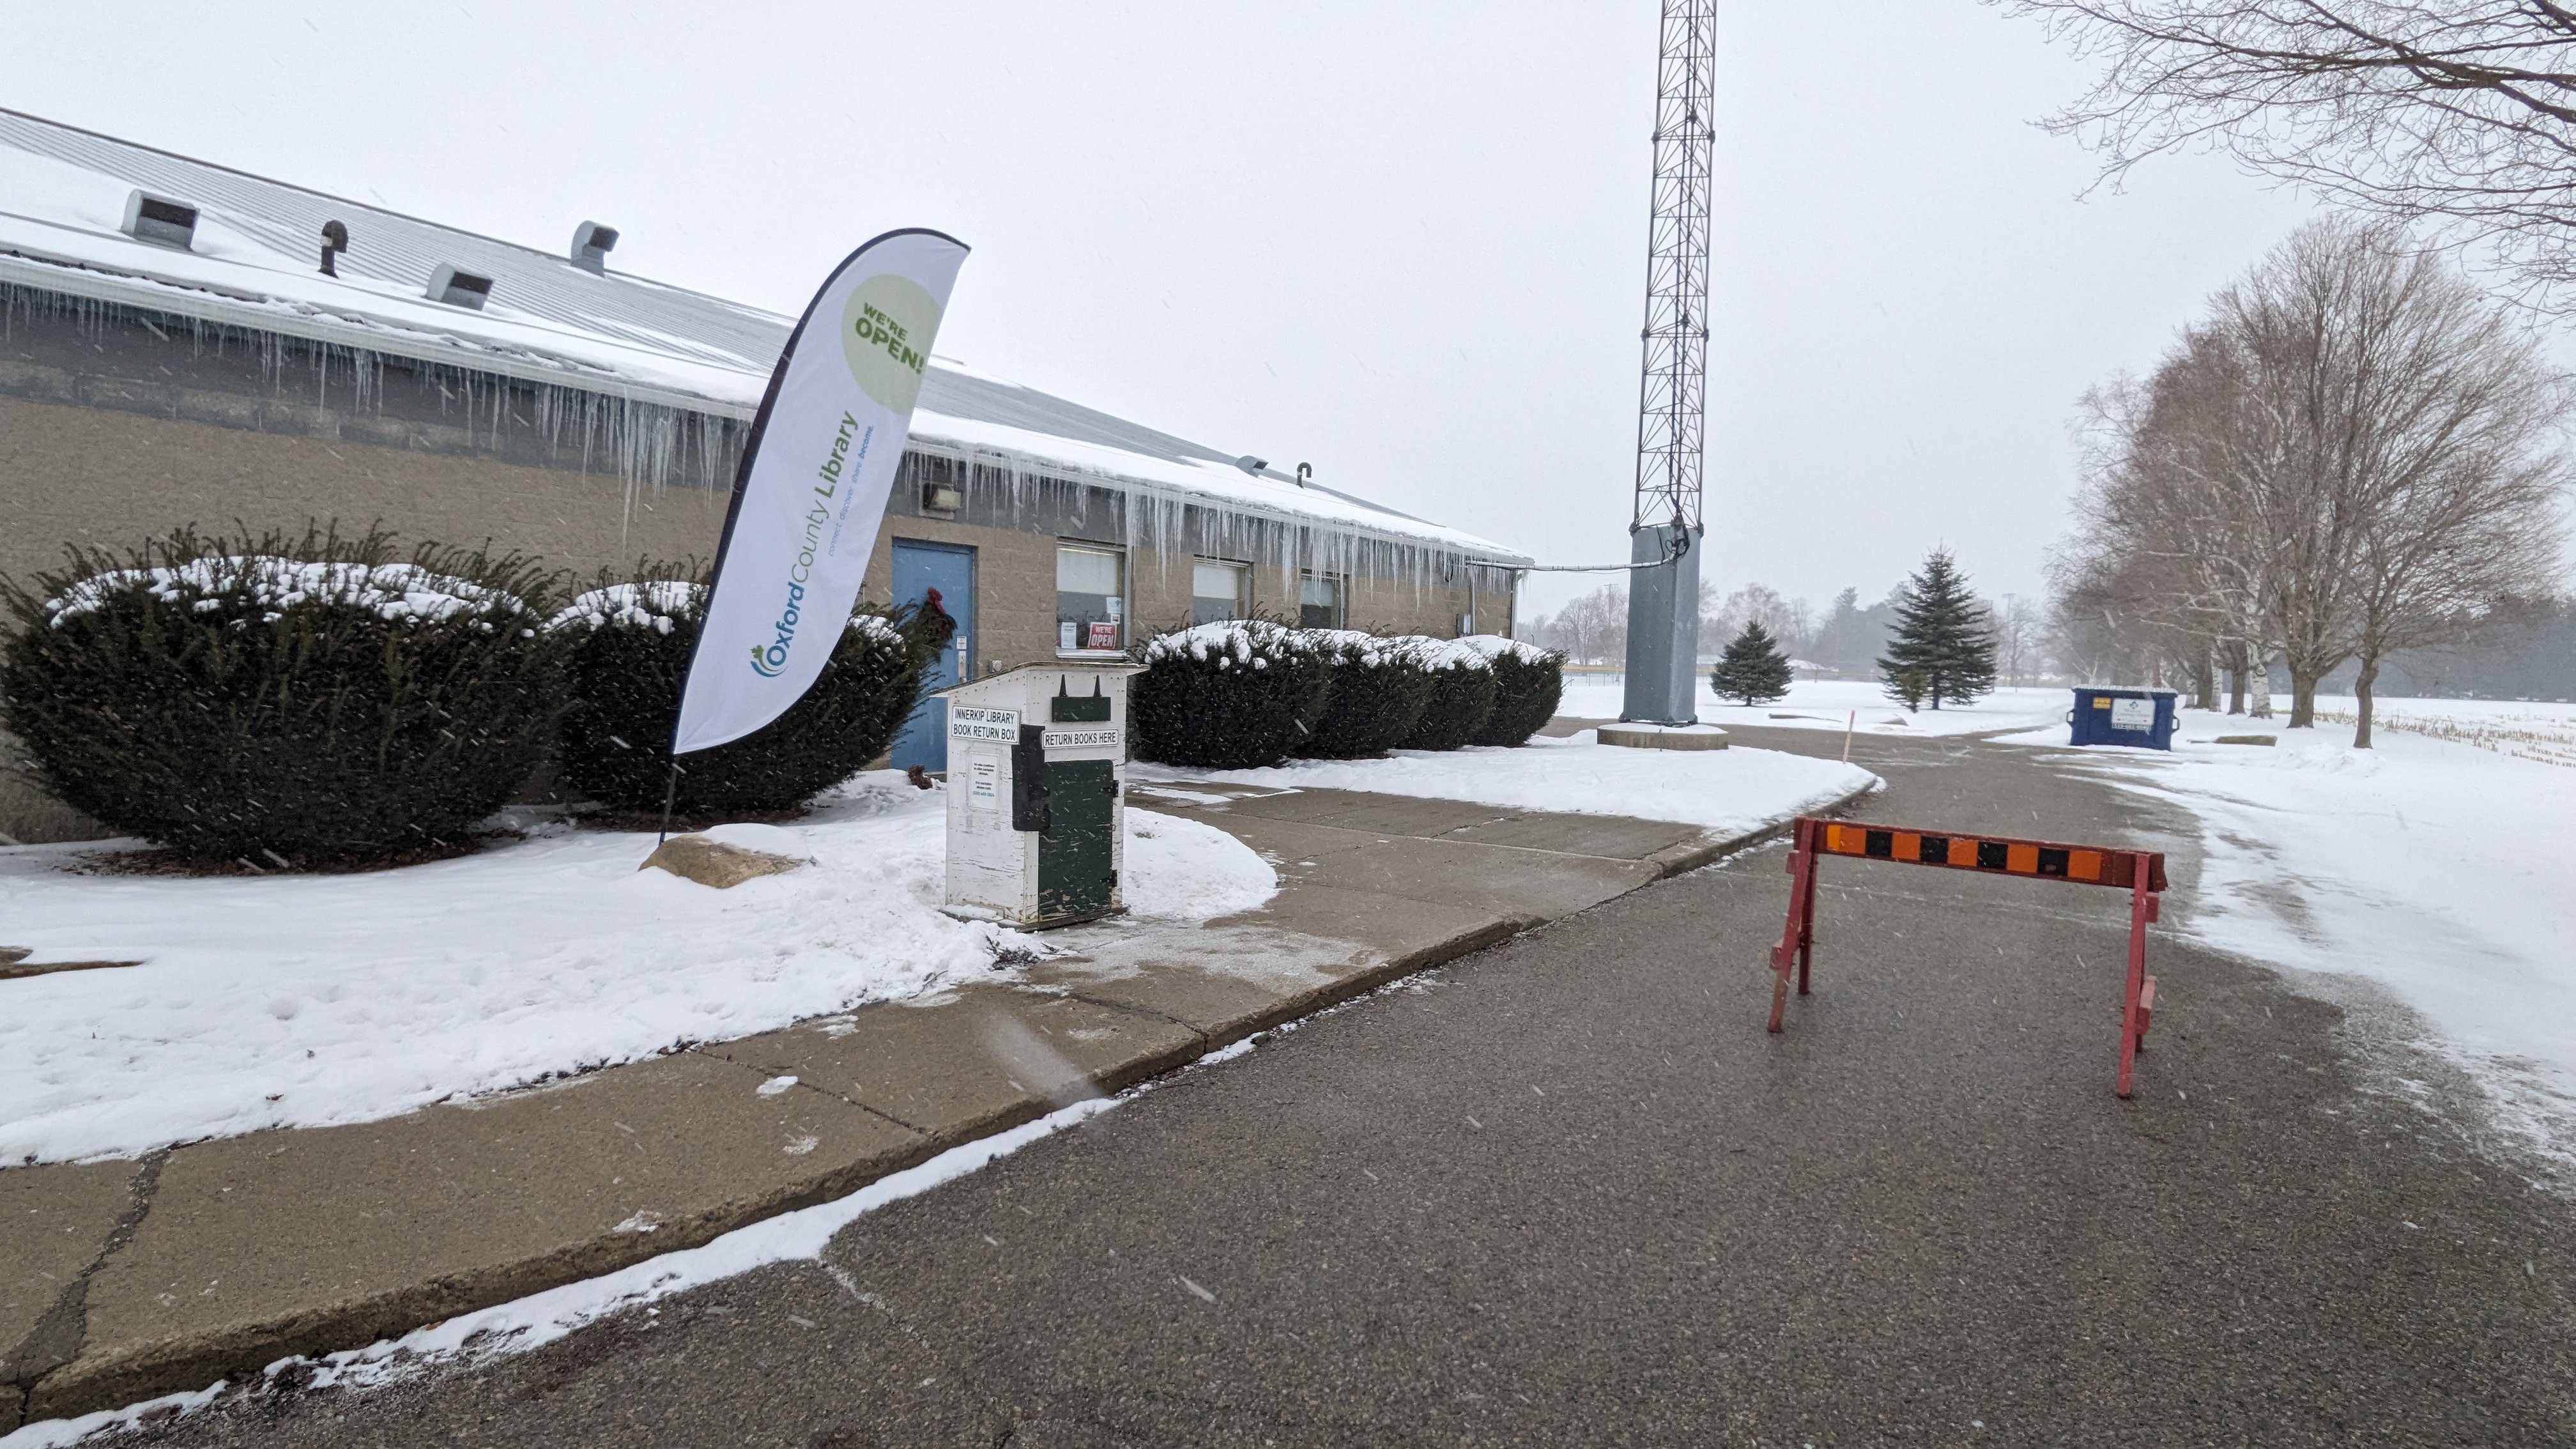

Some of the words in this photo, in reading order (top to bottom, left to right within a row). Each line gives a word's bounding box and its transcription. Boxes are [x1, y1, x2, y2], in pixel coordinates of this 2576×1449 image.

[864, 302, 907, 341] WE'RE
[856, 317, 924, 374] OPEN!
[815, 410, 859, 498] Library
[839, 486, 854, 520] discover
[1091, 634, 1114, 647] OPEN
[954, 708, 985, 721] INNERKIP
[986, 710, 1015, 724] LIBRARY
[954, 723, 972, 736] BOOK
[973, 726, 999, 739] RETURN
[1001, 728, 1016, 741] BOX
[1045, 733, 1073, 746] RETURN
[1075, 733, 1097, 744] BOOKS
[1099, 732, 1116, 743] HERE
